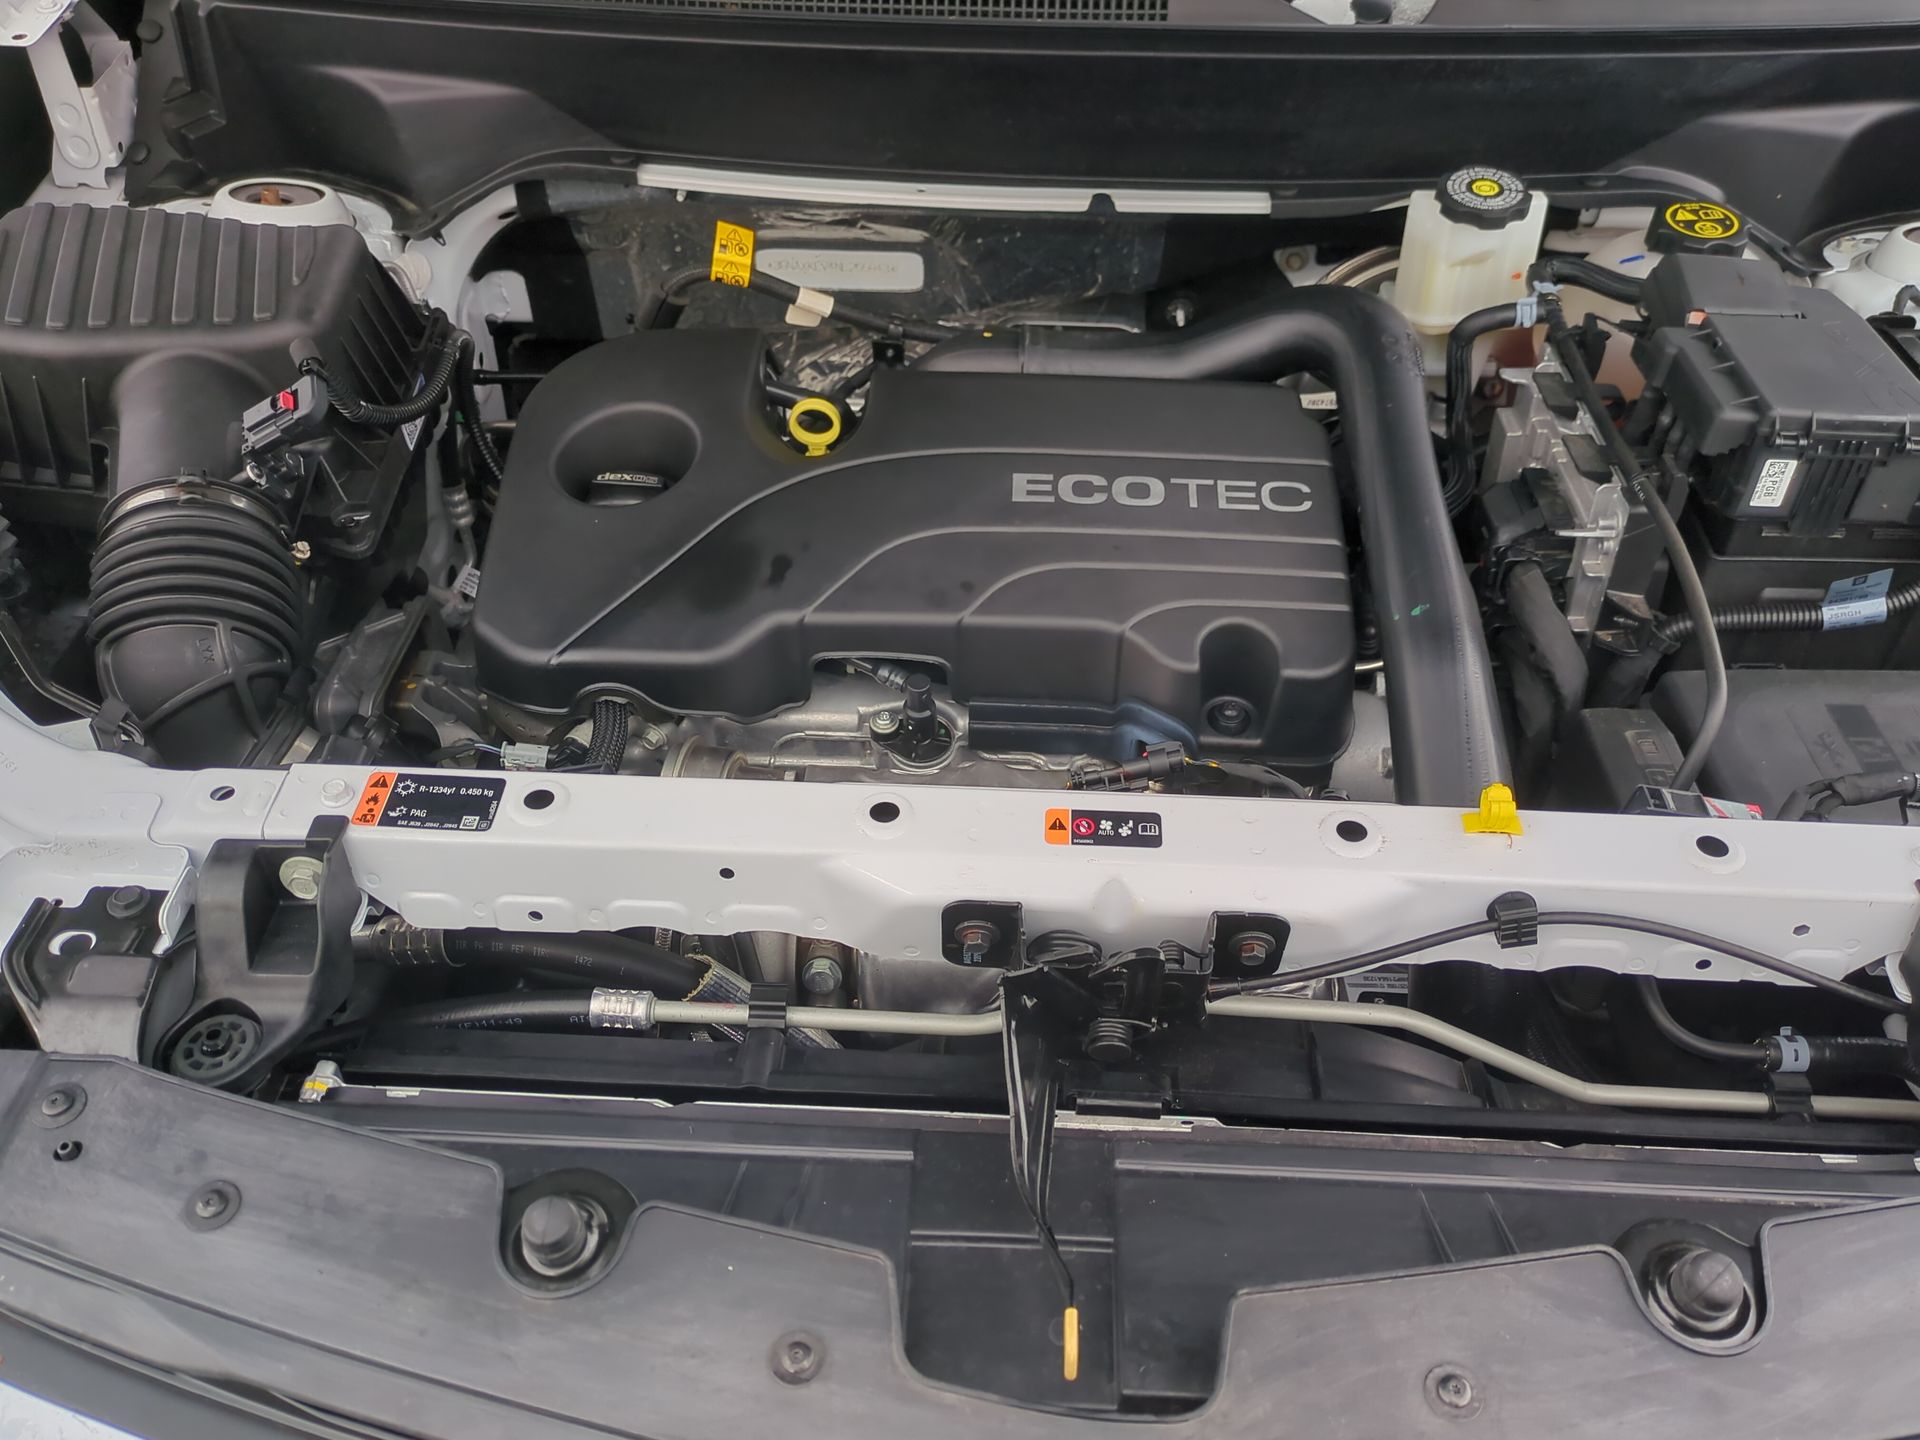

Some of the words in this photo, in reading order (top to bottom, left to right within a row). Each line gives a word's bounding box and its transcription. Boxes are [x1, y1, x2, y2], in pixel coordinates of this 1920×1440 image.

[596, 472, 658, 484] dexos
[1012, 472, 1313, 513] ECOTEC
[418, 785, 456, 795] R-1234yf
[459, 787, 482, 796] 0.450
[483, 788, 494, 797] kg
[409, 808, 427, 818] PAG
